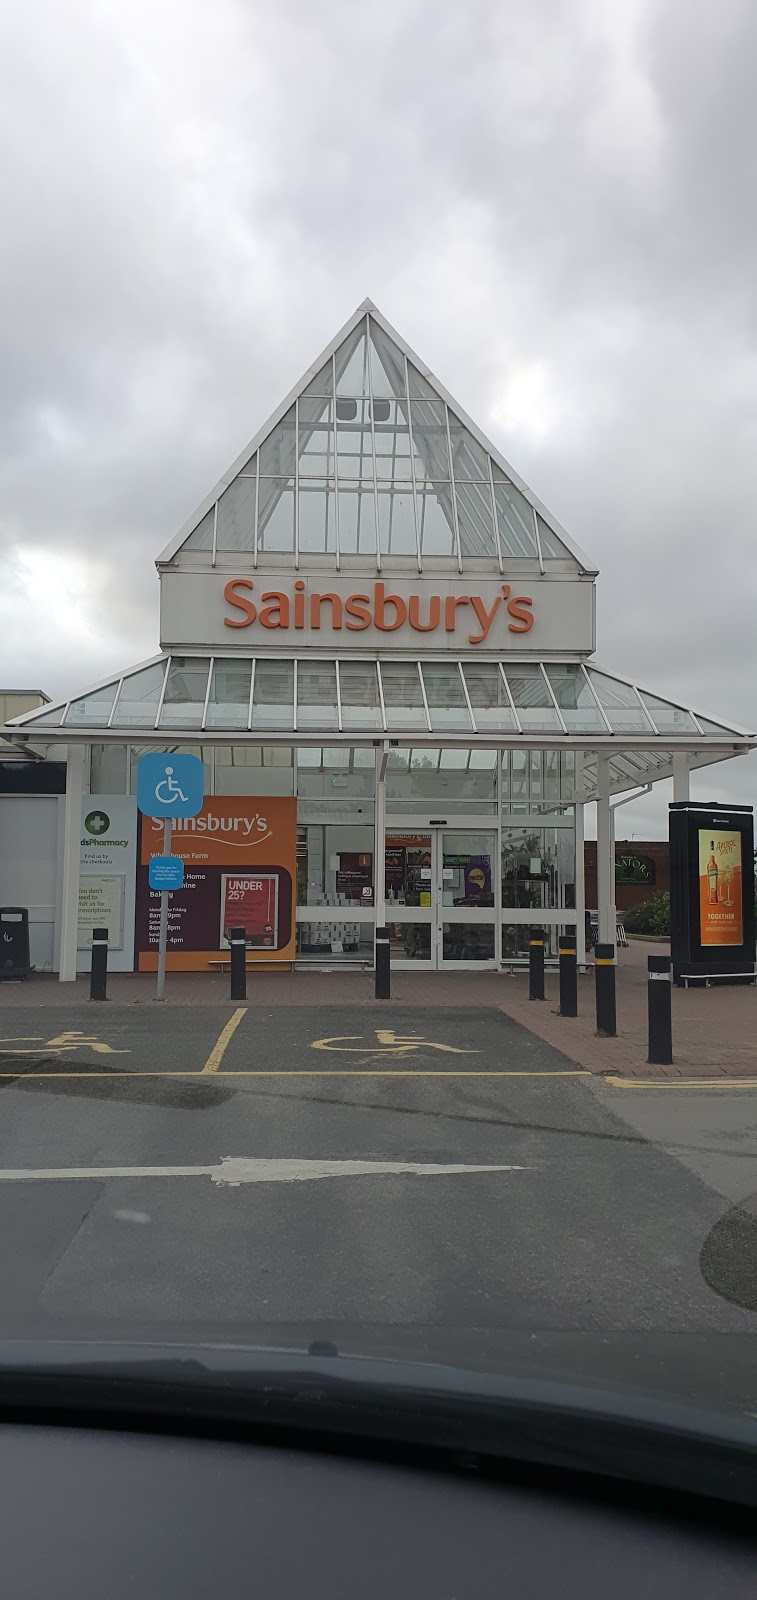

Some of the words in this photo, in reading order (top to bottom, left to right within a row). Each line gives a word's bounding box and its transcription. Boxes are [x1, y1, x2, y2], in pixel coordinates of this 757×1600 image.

[223, 578, 535, 644] Sainsbury's
[80, 838, 129, 848] dsPharmacy
[615, 859, 652, 878] ATORS
[229, 880, 263, 890] UNDER
[228, 891, 245, 900] 25?
